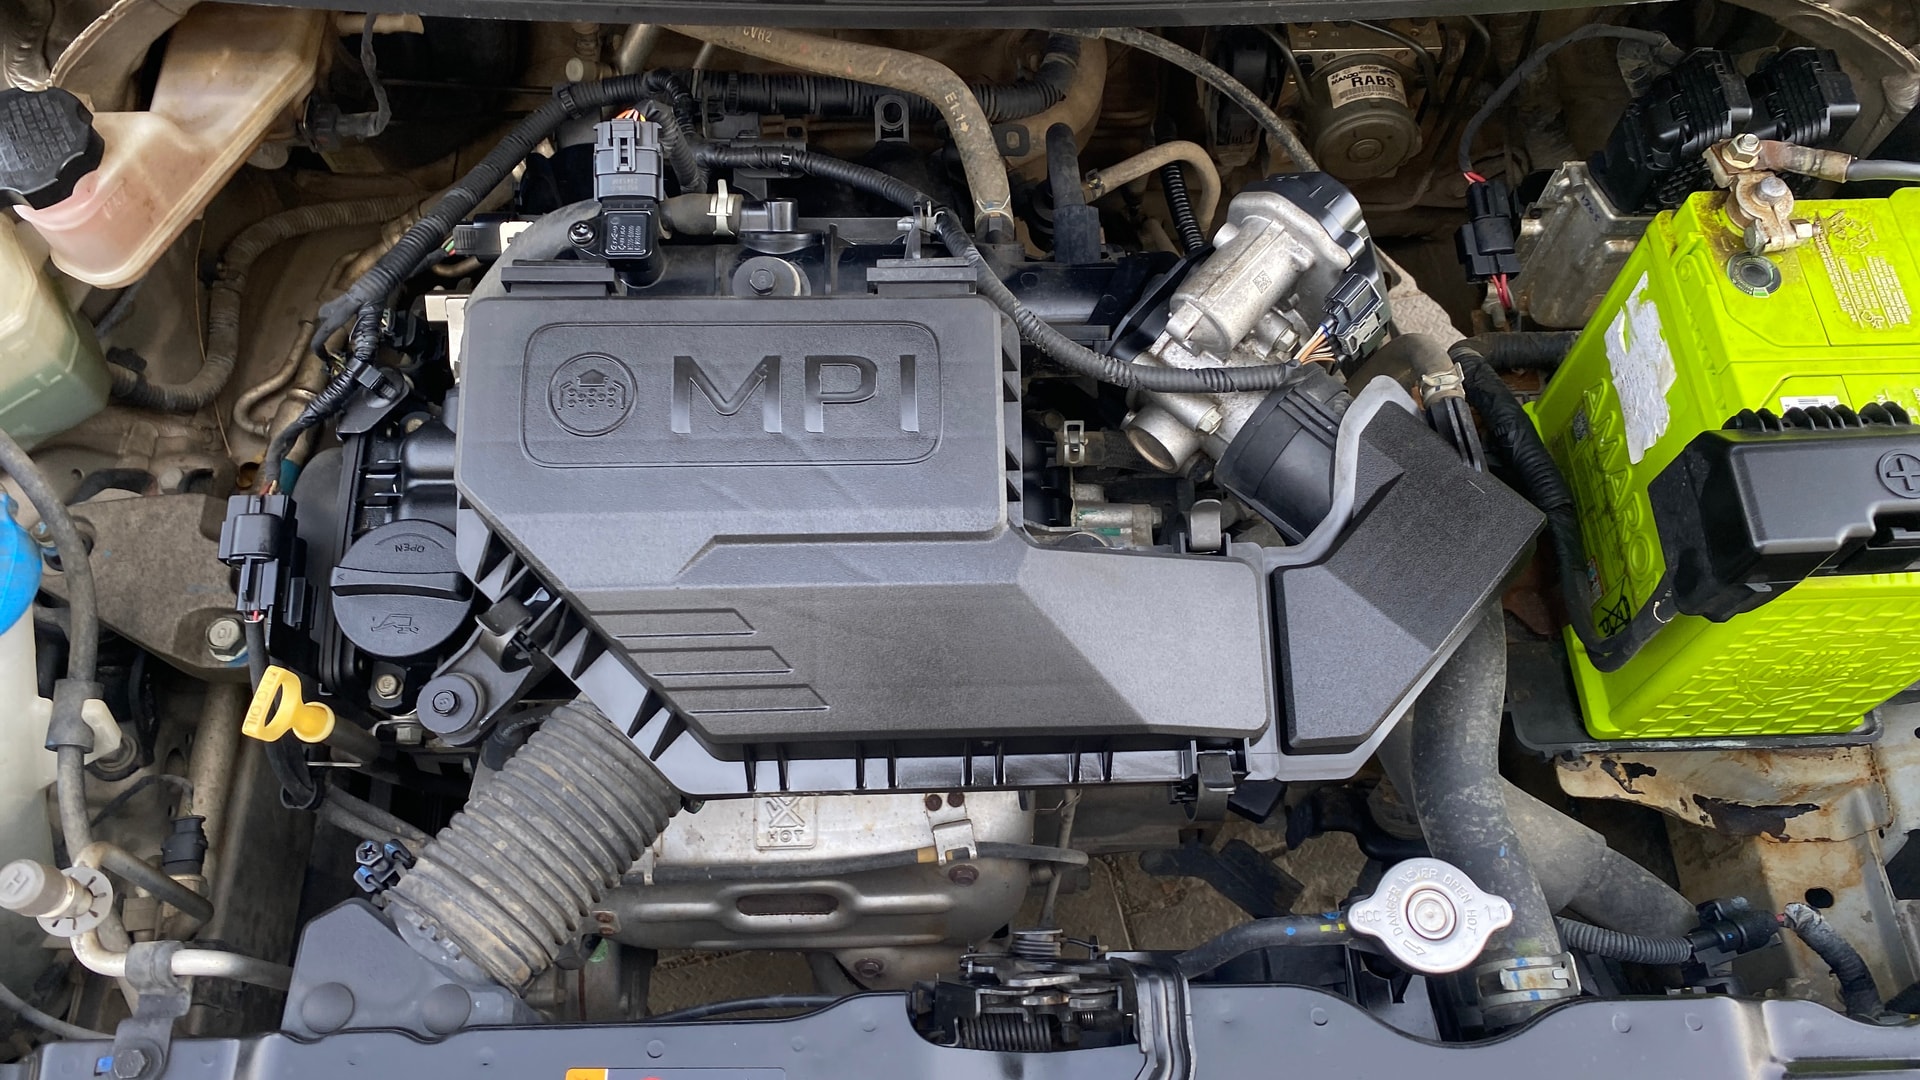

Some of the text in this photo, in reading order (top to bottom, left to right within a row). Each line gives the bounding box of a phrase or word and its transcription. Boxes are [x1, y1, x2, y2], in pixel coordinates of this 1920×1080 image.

[1351, 75, 1396, 88] RABS
[671, 354, 920, 434] MPI
[394, 542, 425, 553] OPEN
[767, 829, 804, 843] HOT
[1386, 885, 1404, 937] DANGER
[1443, 874, 1472, 904] OPEN
[1466, 909, 1478, 935] HOT
